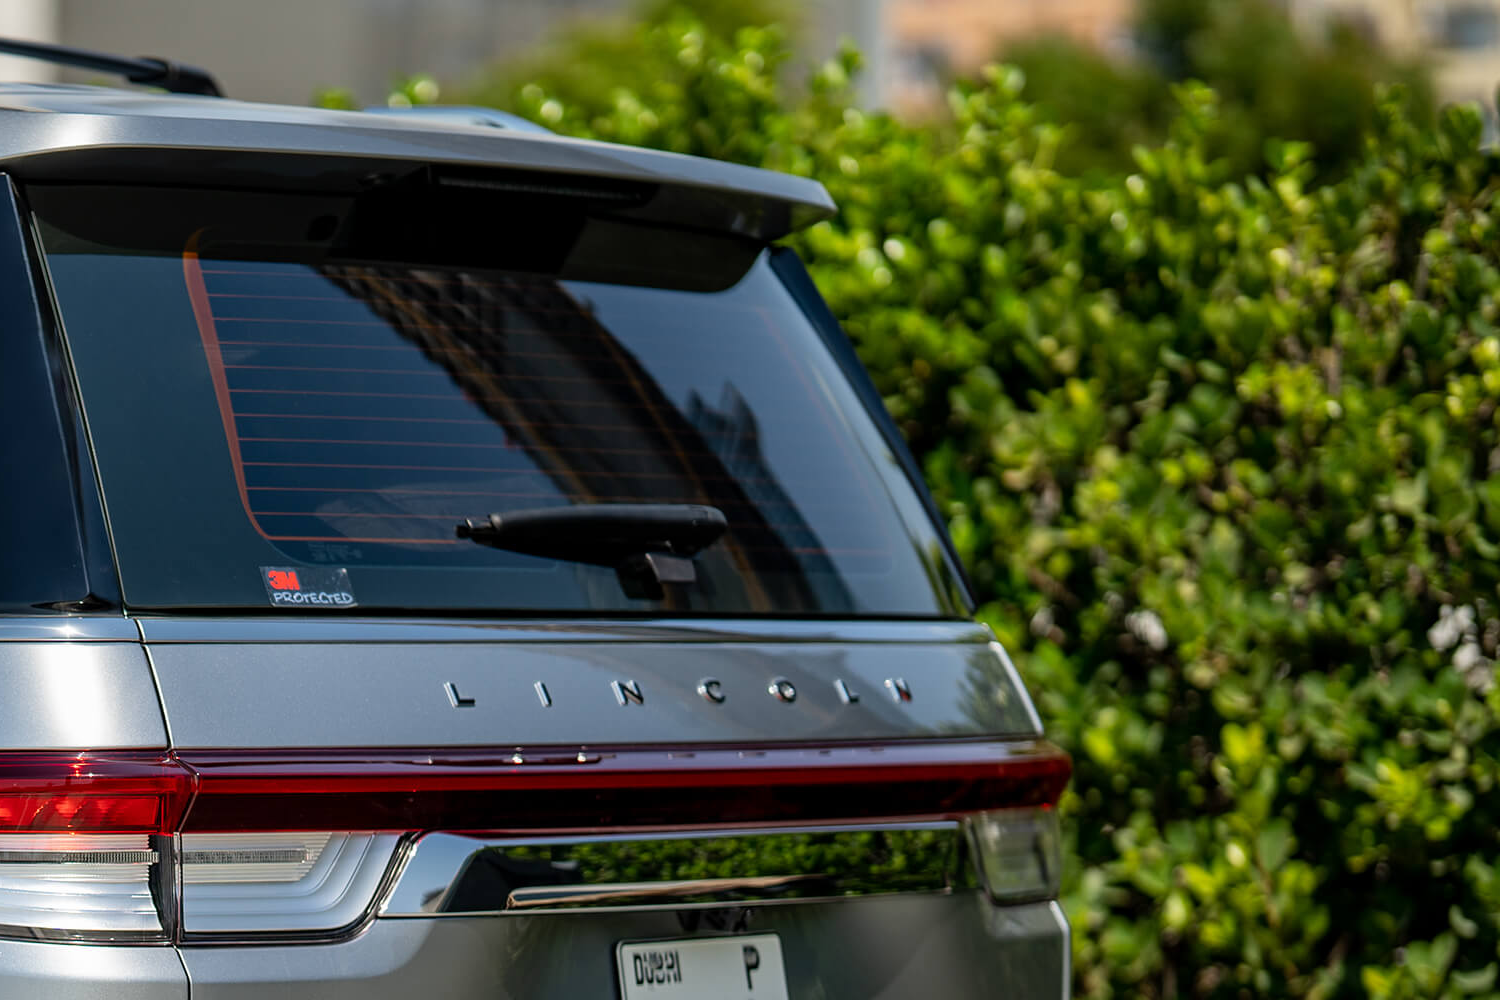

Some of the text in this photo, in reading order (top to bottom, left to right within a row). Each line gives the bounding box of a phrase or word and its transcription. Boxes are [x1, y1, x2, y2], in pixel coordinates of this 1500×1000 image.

[268, 570, 300, 590] 3M
[273, 592, 353, 604] PROTECTED
[443, 676, 912, 708] LINCOLN
[742, 945, 760, 990] P
